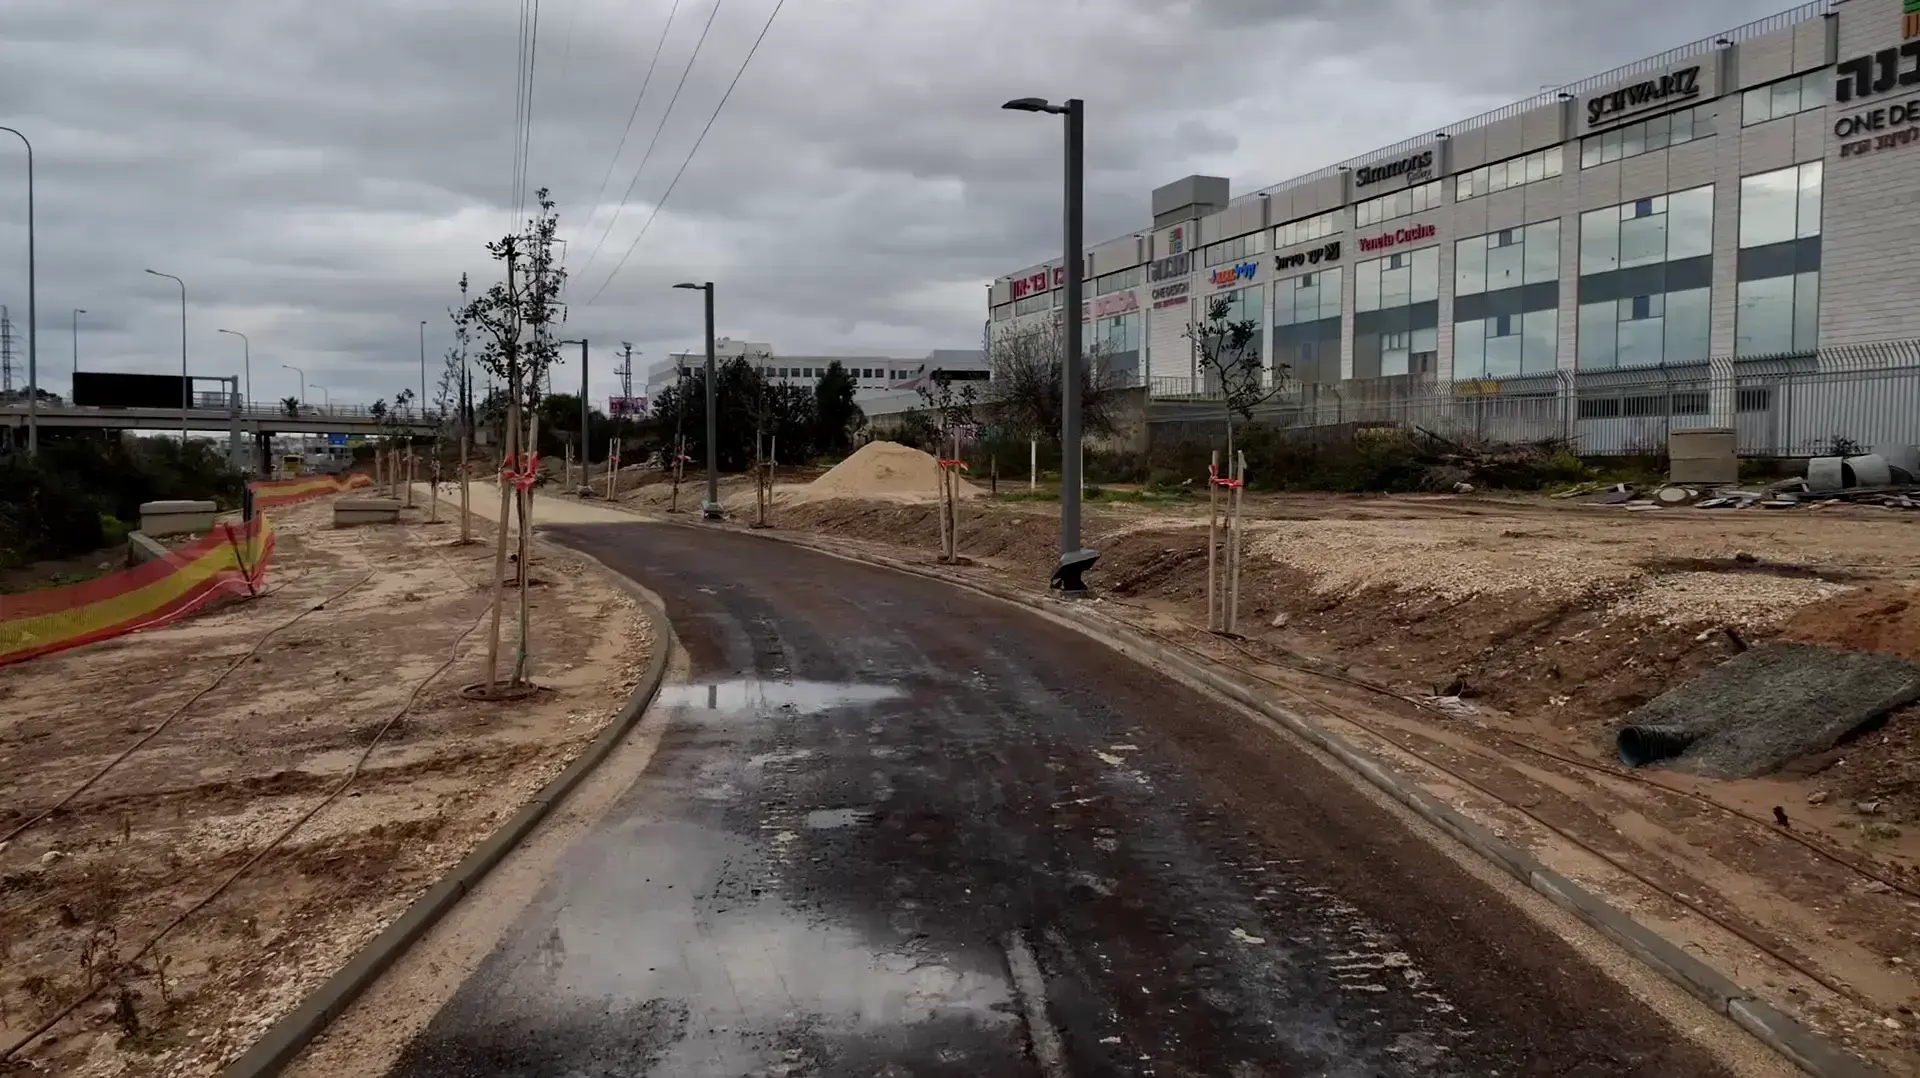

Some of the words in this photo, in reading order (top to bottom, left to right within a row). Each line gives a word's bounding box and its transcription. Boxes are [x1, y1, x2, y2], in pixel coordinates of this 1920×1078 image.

[1587, 65, 1700, 124] SCHWARTZ
[1834, 107, 1885, 137] ONE
[1356, 150, 1433, 187] Simmons
[1395, 223, 1436, 244] Cucine
